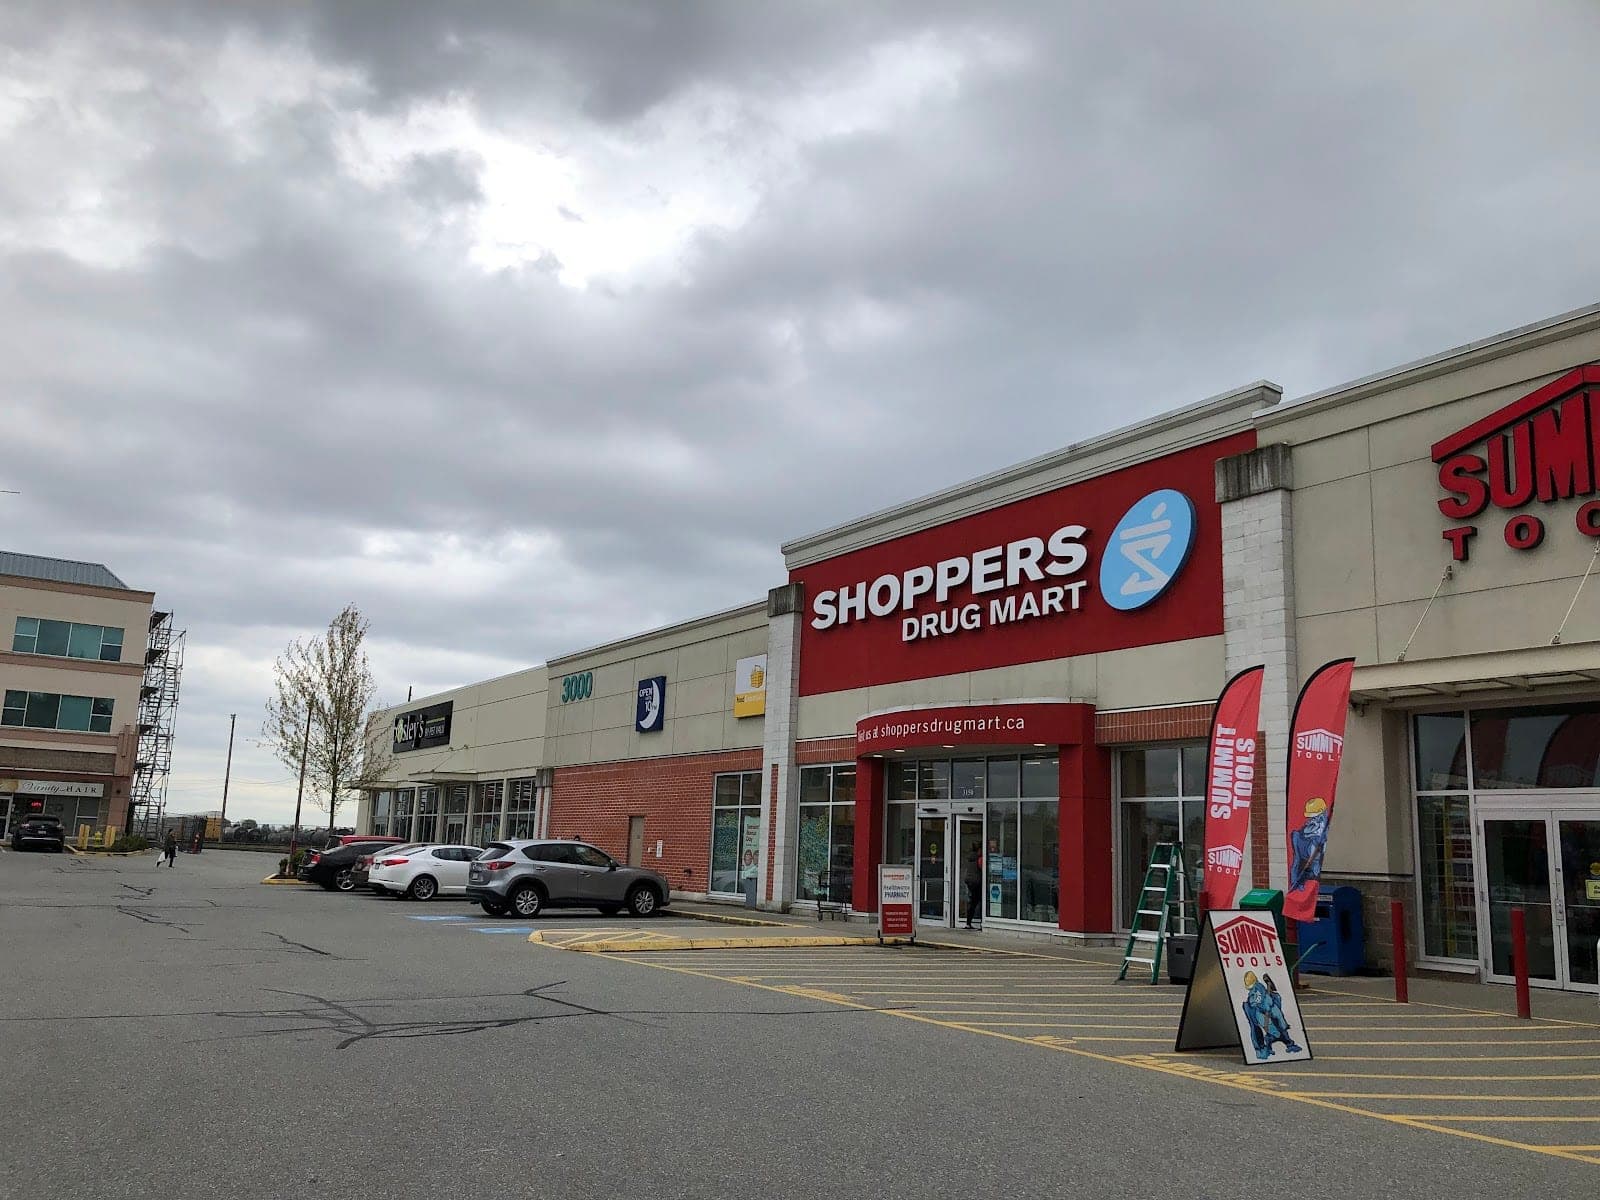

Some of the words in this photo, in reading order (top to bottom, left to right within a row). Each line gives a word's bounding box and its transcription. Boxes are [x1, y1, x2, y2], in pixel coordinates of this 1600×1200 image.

[1438, 389, 1600, 519] SUM
[811, 525, 1088, 630] SHOPPERS
[902, 604, 981, 642] DRUG
[990, 580, 1087, 625] MART
[562, 671, 593, 703] 3000
[639, 687, 653, 697] OPEN
[872, 725, 878, 738] at
[881, 716, 1025, 739] shoppersdrugmart.ca
[1296, 732, 1343, 754] SUMMIT
[1211, 723, 1236, 820] SUMMIT
[1232, 737, 1256, 810] TOOLS
[66, 785, 97, 794] HAIR
[1217, 923, 1277, 955] SUMMIT
[1222, 955, 1283, 968] TOOLS
